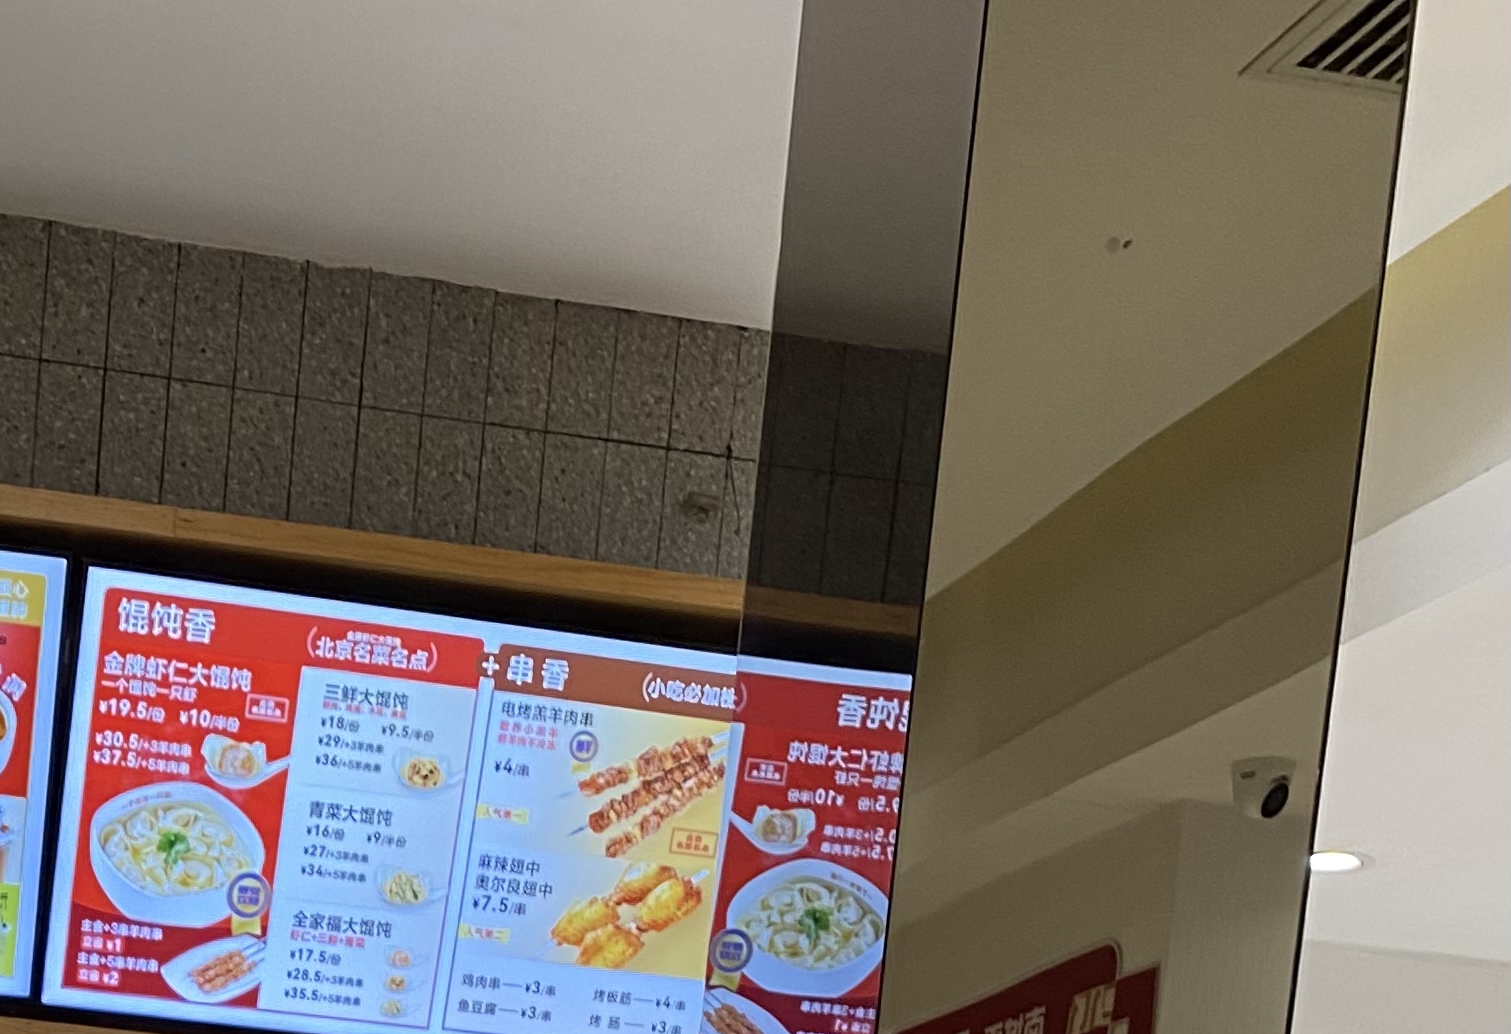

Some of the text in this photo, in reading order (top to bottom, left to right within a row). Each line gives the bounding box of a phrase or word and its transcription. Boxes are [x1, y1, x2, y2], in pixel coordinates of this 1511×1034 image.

[118, 597, 216, 644] 馄饨香
[103, 651, 252, 692] 金牌虾仁大馄饨
[506, 653, 570, 691] 串香
[323, 683, 409, 710] 三鲜大馄饨
[501, 700, 594, 727] 电烤羔羊肉串
[309, 800, 393, 827] 青菜大馄饨
[478, 853, 541, 876] 麻辣翅中
[475, 875, 554, 898] 奥尔良翅中
[292, 910, 392, 938] 全家福大馄饨
